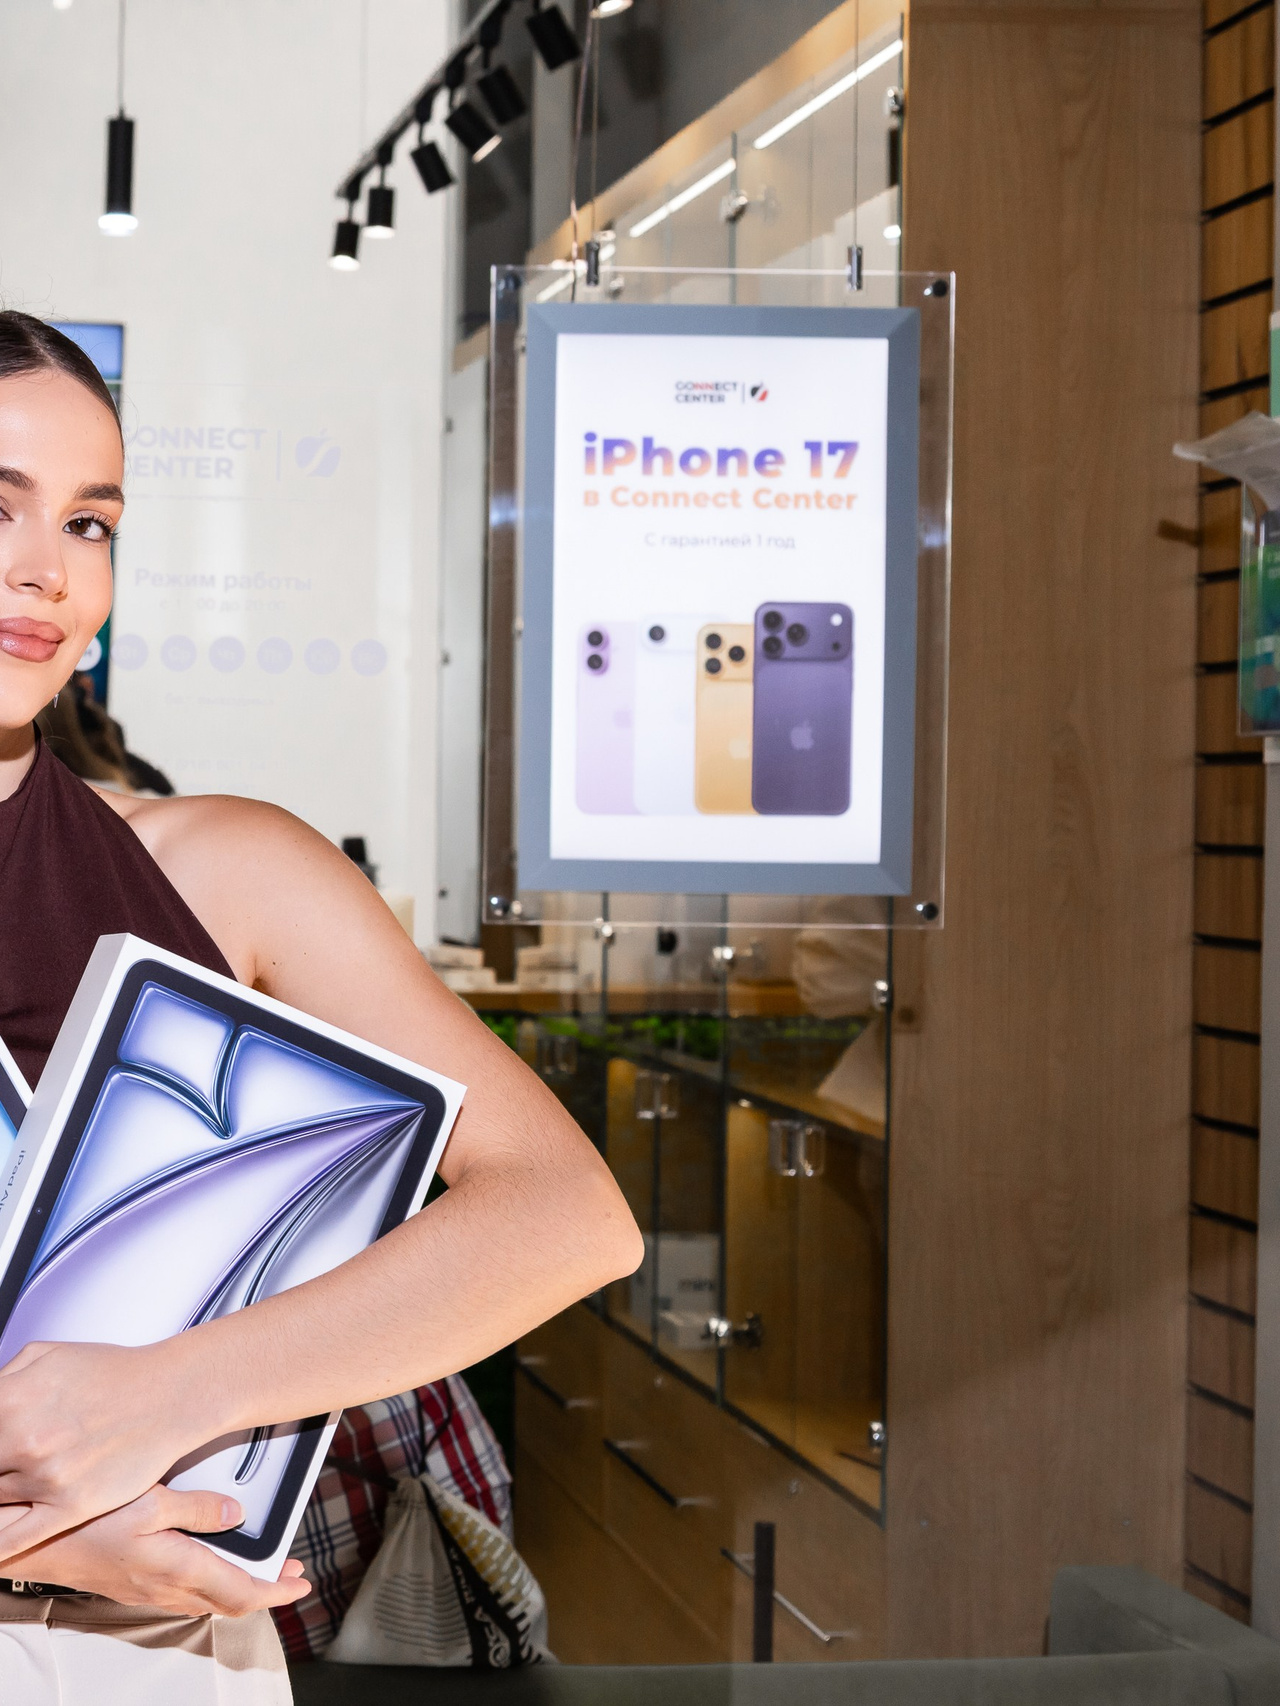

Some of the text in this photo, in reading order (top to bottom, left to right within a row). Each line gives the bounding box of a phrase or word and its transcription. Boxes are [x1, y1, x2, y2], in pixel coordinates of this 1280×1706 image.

[675, 381, 738, 392] CONNECT
[675, 393, 726, 404] CENTER
[127, 454, 234, 479] ENTER
[583, 431, 860, 479] iPhone 17
[610, 485, 742, 509] Connect
[752, 487, 858, 510] Center
[661, 532, 752, 549] гарантией
[767, 536, 797, 550] год
[134, 567, 312, 593] Режим работы
[7, 1150, 27, 1187] iPad
